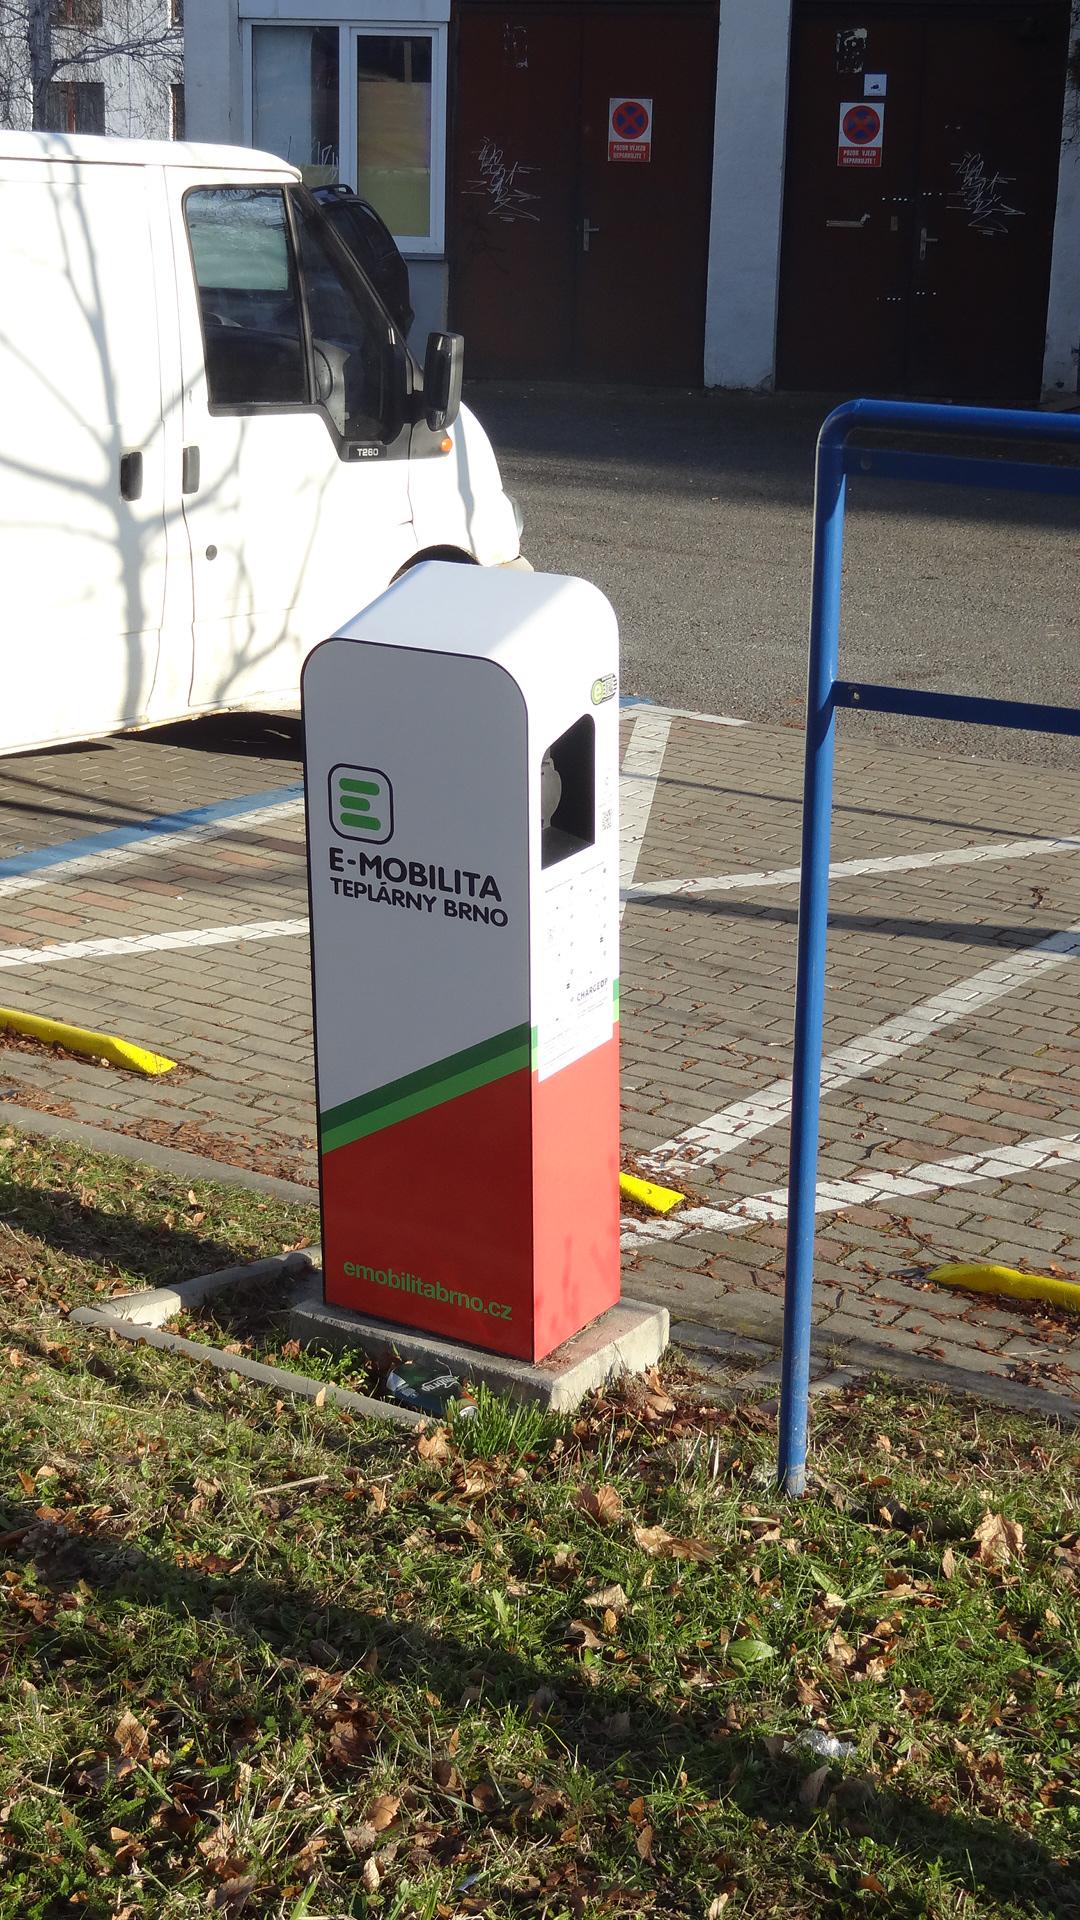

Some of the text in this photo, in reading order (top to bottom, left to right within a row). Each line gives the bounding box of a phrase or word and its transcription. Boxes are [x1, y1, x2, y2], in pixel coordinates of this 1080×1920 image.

[328, 846, 503, 903] E-MOBILITA
[329, 876, 509, 928] TEPLÁRNY BRNO
[343, 1261, 513, 1321] emobilitabrno.cz
